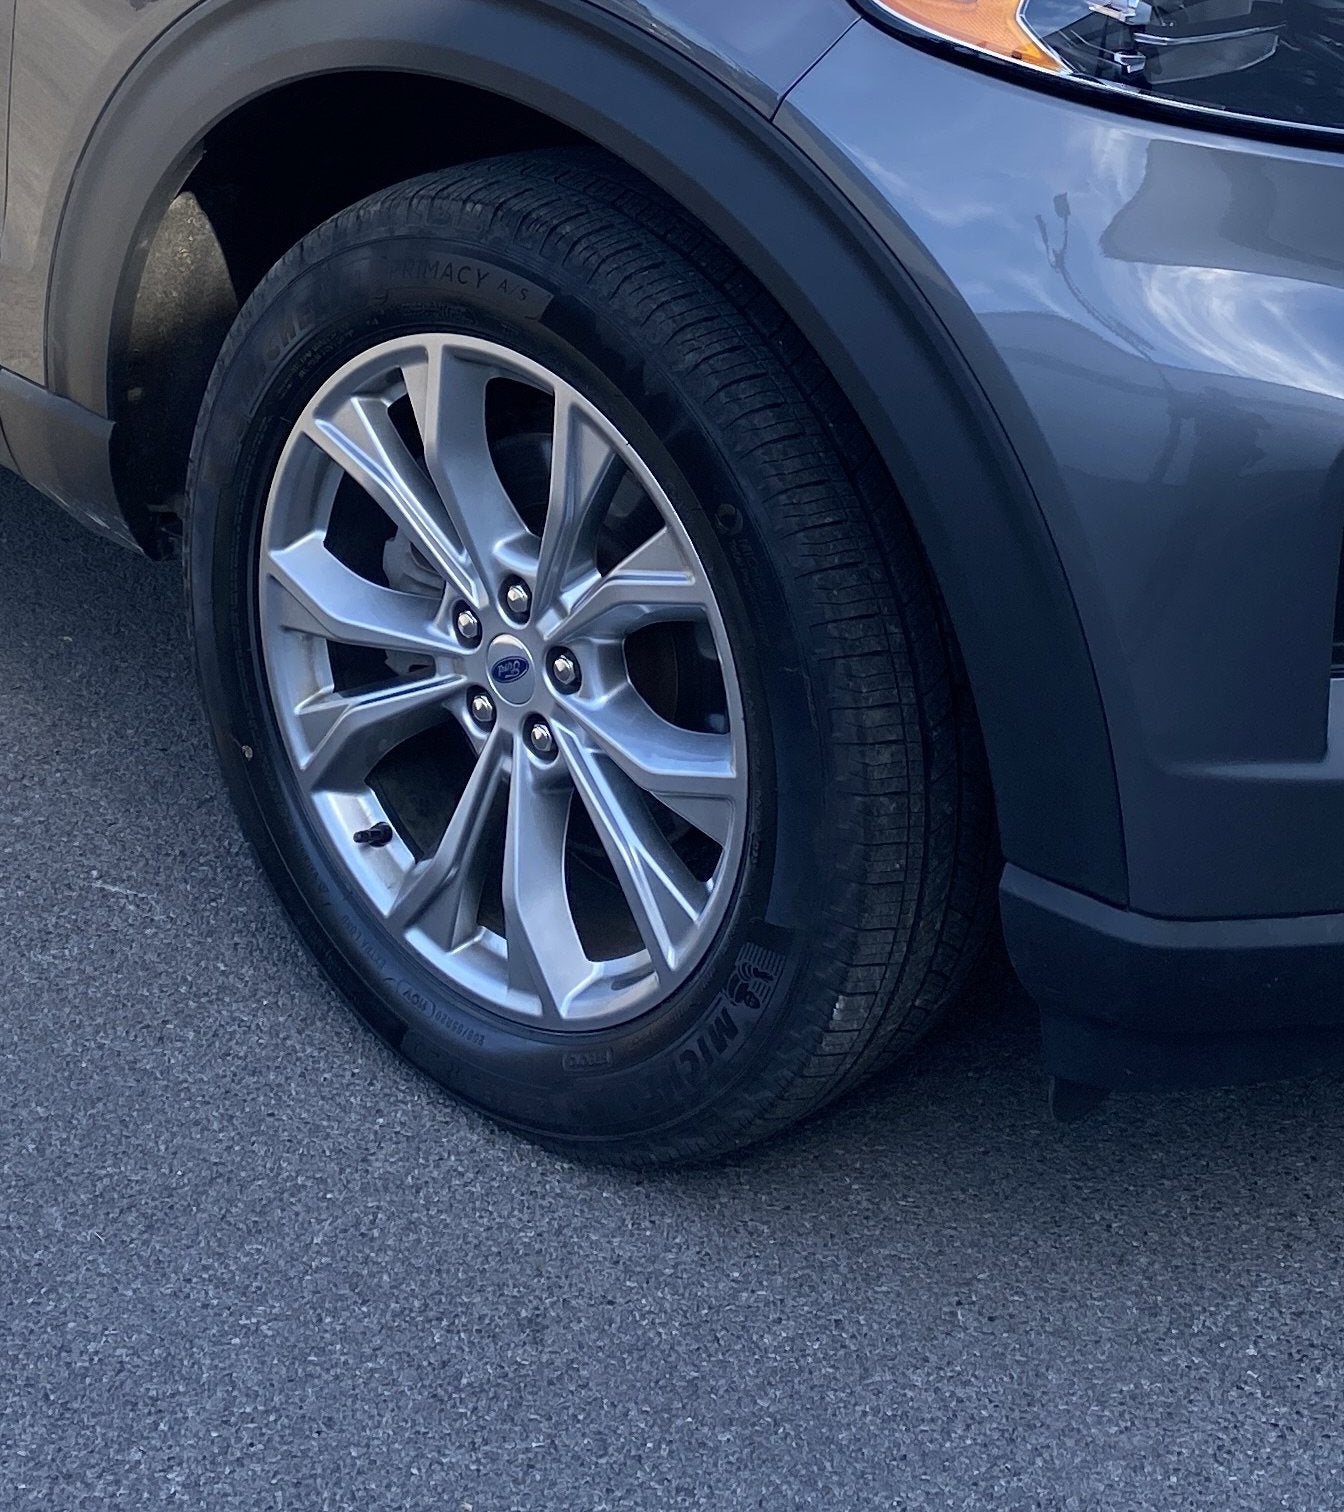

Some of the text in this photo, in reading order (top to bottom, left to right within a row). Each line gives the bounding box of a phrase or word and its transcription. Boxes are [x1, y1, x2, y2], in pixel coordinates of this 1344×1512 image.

[387, 258, 529, 302] PRIMACY A/S
[497, 659, 523, 679] Ford
